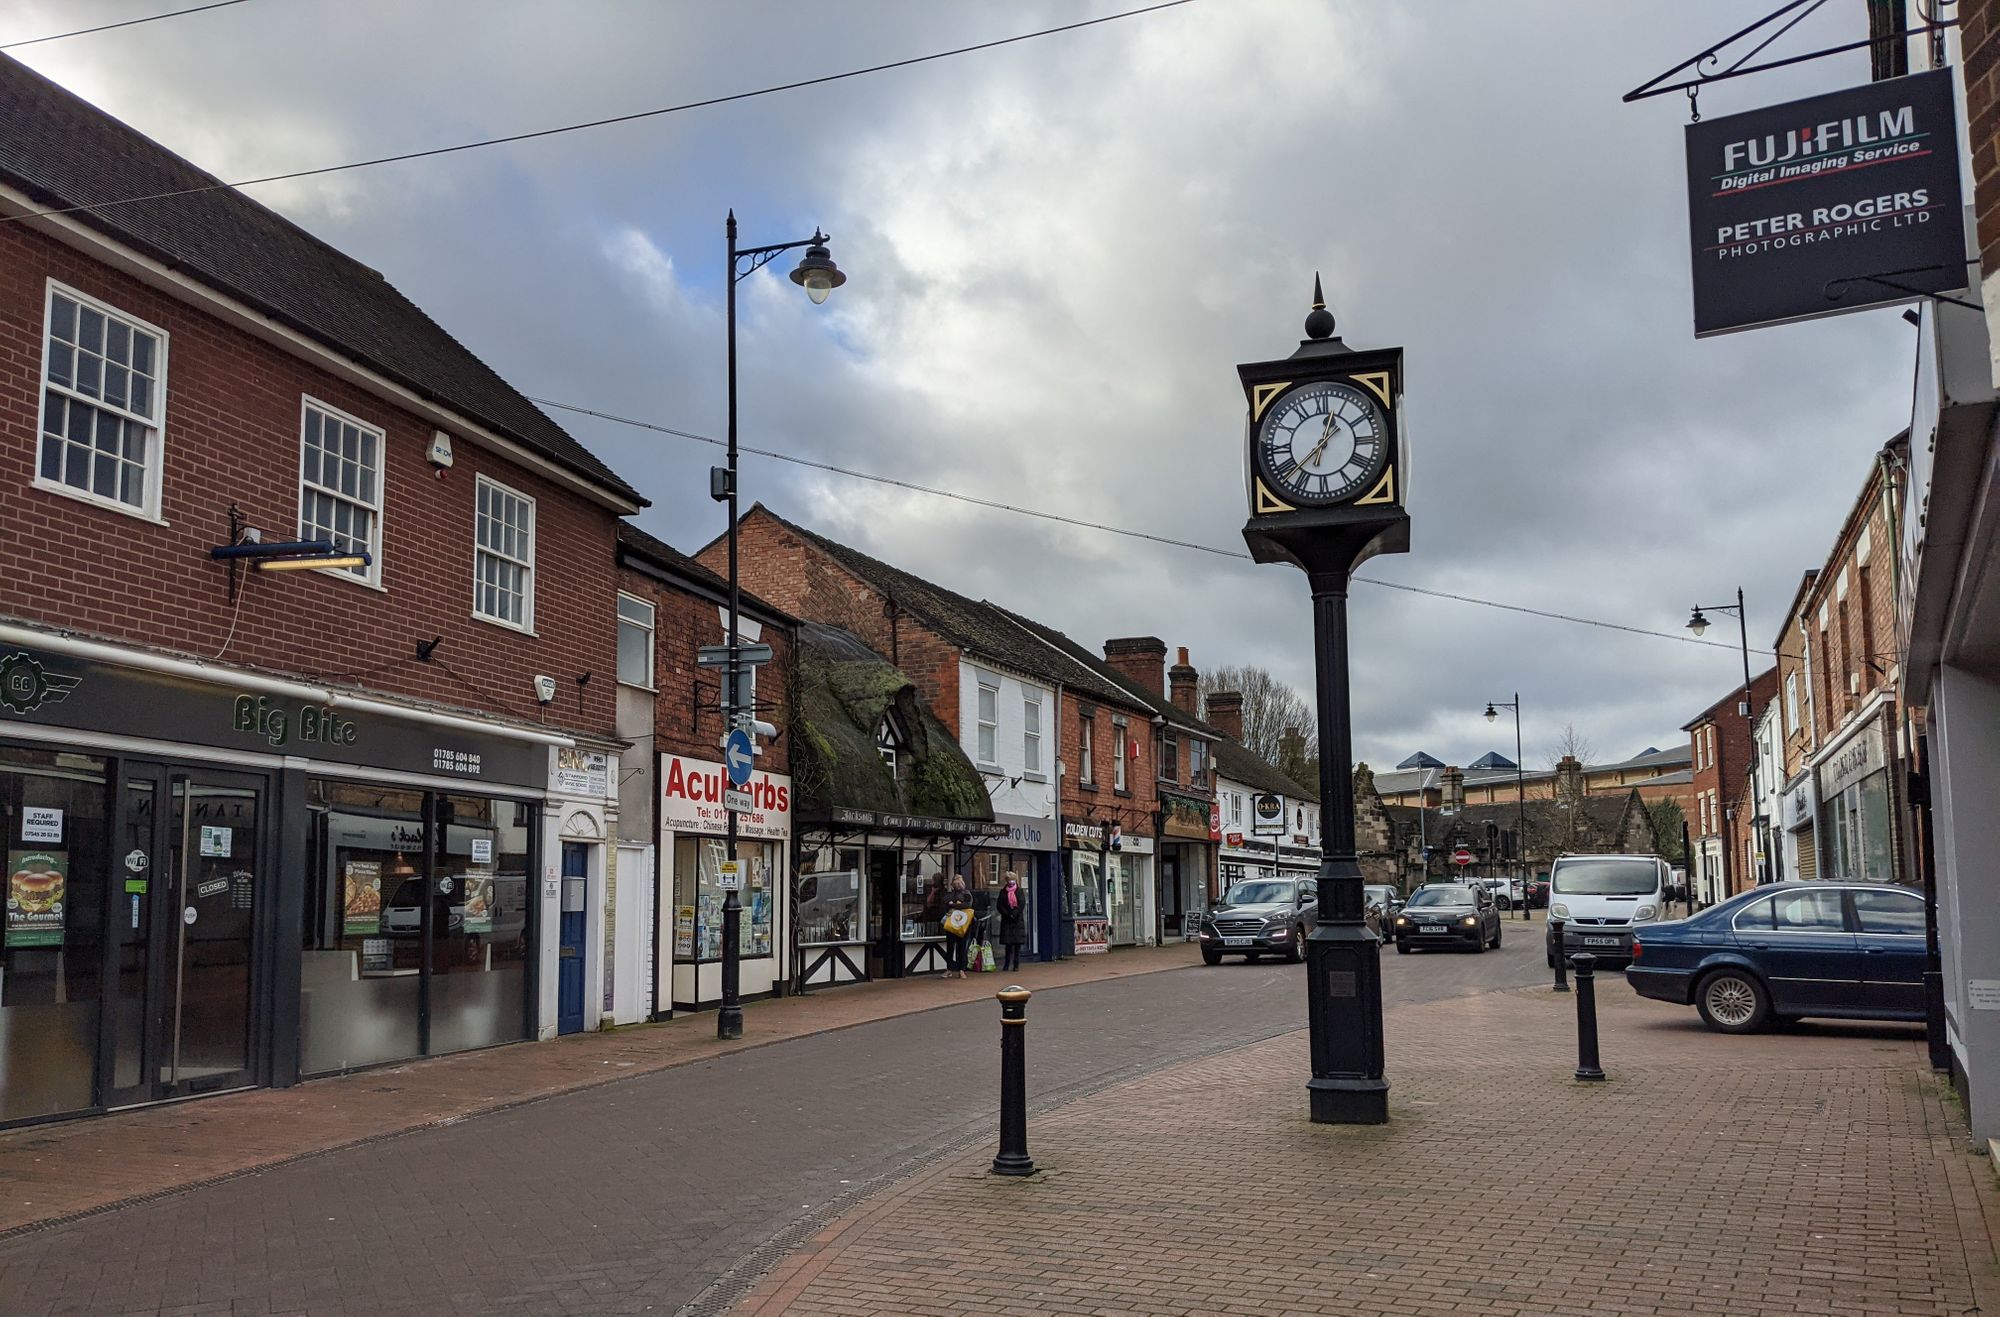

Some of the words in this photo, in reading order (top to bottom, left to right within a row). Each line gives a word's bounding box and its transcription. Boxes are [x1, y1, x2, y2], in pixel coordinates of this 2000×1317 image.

[1724, 106, 1915, 172] FUJIFILM
[1721, 163, 1775, 190] Digital
[1780, 155, 1848, 179] Imaging
[1853, 141, 1920, 163] Service
[1718, 213, 1805, 244] PETER
[1813, 189, 1929, 227] ROGERS
[1719, 220, 1882, 260] PHOTOGRAPHIC
[1894, 211, 1931, 229] LTD
[233, 694, 288, 746] Big
[300, 705, 358, 746] Bite
[433, 748, 455, 760] 01785
[455, 751, 468, 762] 604
[468, 753, 481, 764] 840
[433, 758, 454, 770] 01785
[455, 762, 468, 772] 604
[468, 763, 481, 774] 892
[726, 794, 738, 806] One
[739, 798, 751, 810] way
[32, 812, 54, 820] STAFF
[697, 806, 711, 818] Tel:
[26, 819, 59, 827] REQUIRED
[665, 816, 700, 830] Acupuncture
[703, 820, 722, 832] Chinese
[1065, 822, 1088, 836] GOLDEN
[1088, 826, 1103, 839] CUTS
[1023, 823, 1042, 843] Uno
[200, 880, 227, 894] CLOSED
[8, 912, 26, 921] The
[27, 912, 63, 921] Gourmet
